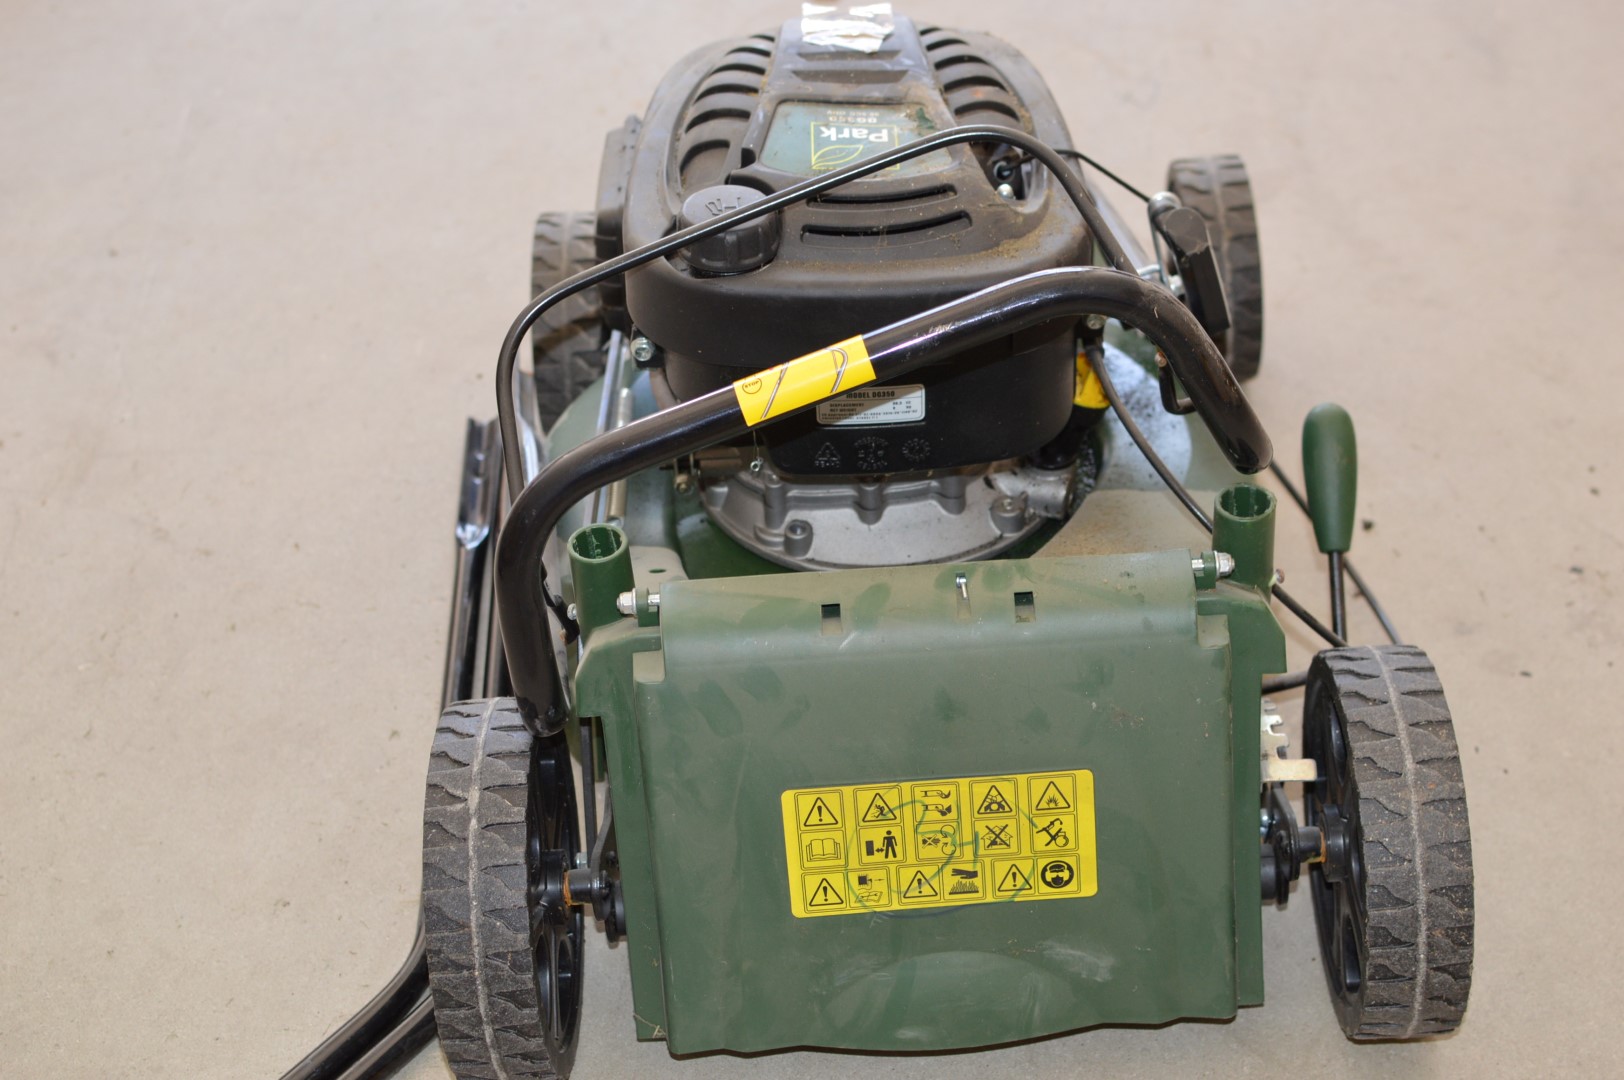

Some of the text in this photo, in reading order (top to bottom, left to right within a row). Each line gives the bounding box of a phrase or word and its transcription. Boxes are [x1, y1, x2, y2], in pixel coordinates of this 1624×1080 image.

[819, 126, 889, 143] Park
[744, 380, 760, 389] STOP
[846, 391, 871, 399] MODEL
